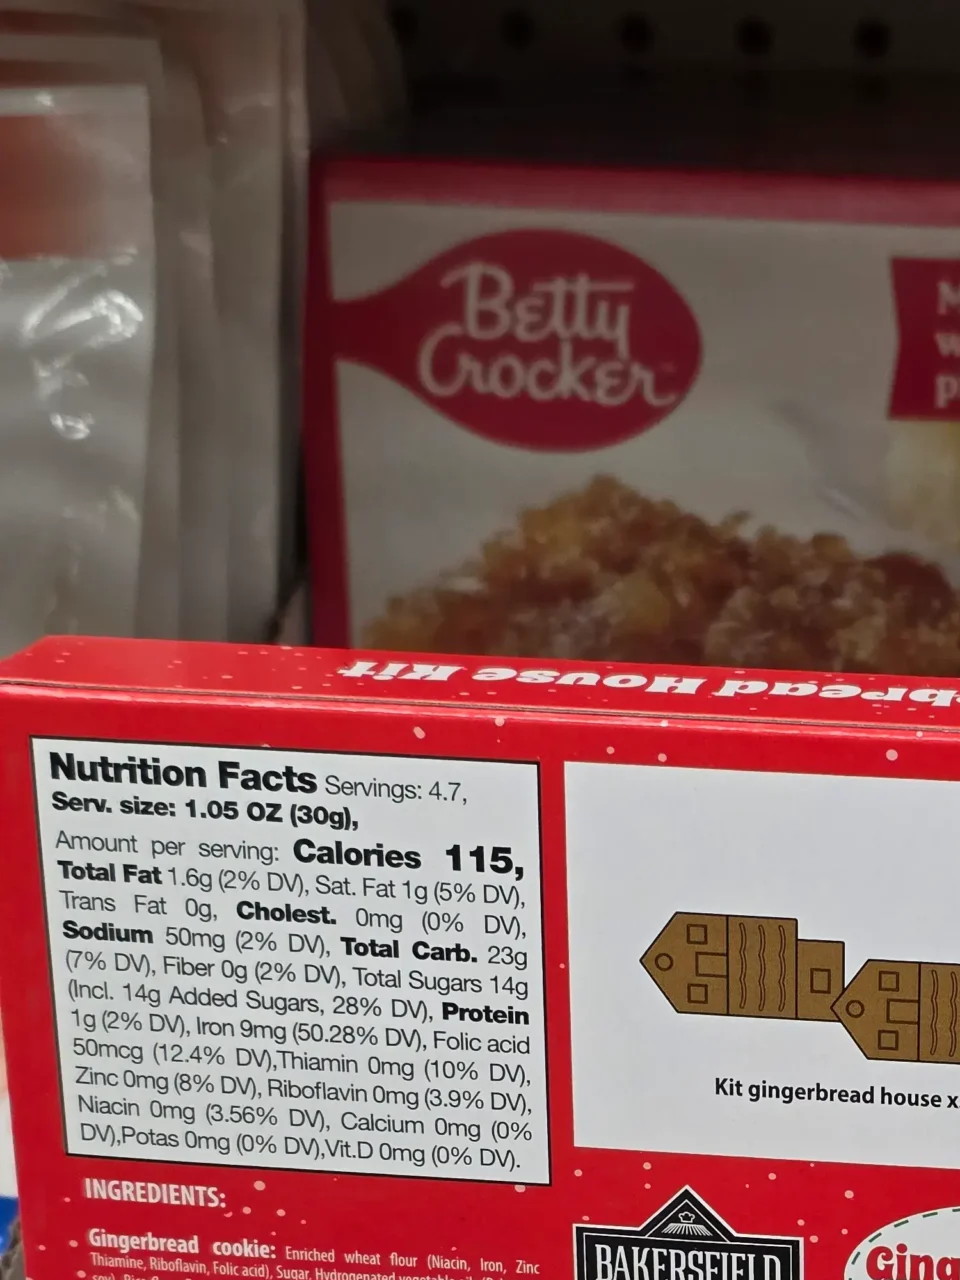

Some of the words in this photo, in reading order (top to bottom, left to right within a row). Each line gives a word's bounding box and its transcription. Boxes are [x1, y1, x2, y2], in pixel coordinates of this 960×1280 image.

[439, 261, 634, 361] Betty
[416, 323, 680, 409] Crocker
[338, 659, 459, 681] Kit
[473, 664, 708, 694] House
[50, 753, 207, 787] Nutrition
[218, 761, 317, 794] Facts
[326, 774, 422, 804] Servings:
[429, 781, 467, 805] 4.7,
[52, 791, 112, 814] Serv.
[120, 795, 175, 817] size:
[185, 799, 238, 820] 1.05
[247, 802, 282, 822] OZ
[290, 803, 358, 832] (30g),
[56, 831, 138, 854] Amount
[152, 839, 186, 859] per
[199, 840, 279, 866] serving:
[294, 838, 421, 870] Calories
[446, 844, 525, 880] 115,
[57, 860, 115, 882] Total
[123, 864, 162, 885] Fat
[168, 867, 212, 892] 1.6g
[219, 869, 260, 893] (2%
[267, 871, 308, 897] DV),
[316, 874, 355, 896] Sat.
[363, 877, 396, 899] Fat
[402, 880, 427, 905] 1g
[434, 881, 475, 905] (5%
[483, 884, 524, 909] DV),
[716, 1078, 743, 1097] Kit
[749, 1080, 874, 1105] gingerbread
[881, 1086, 942, 1108] house
[85, 1177, 226, 1209] INGREDIENTS:
[88, 1228, 199, 1254] Gingerbread
[212, 1237, 275, 1259] cookie:
[286, 1246, 335, 1262] Enriched
[345, 1251, 381, 1265] wheat
[390, 1252, 418, 1267] flour
[428, 1254, 471, 1271] (Niacin,
[481, 1258, 507, 1274] Iron,
[516, 1259, 540, 1274] Zinc
